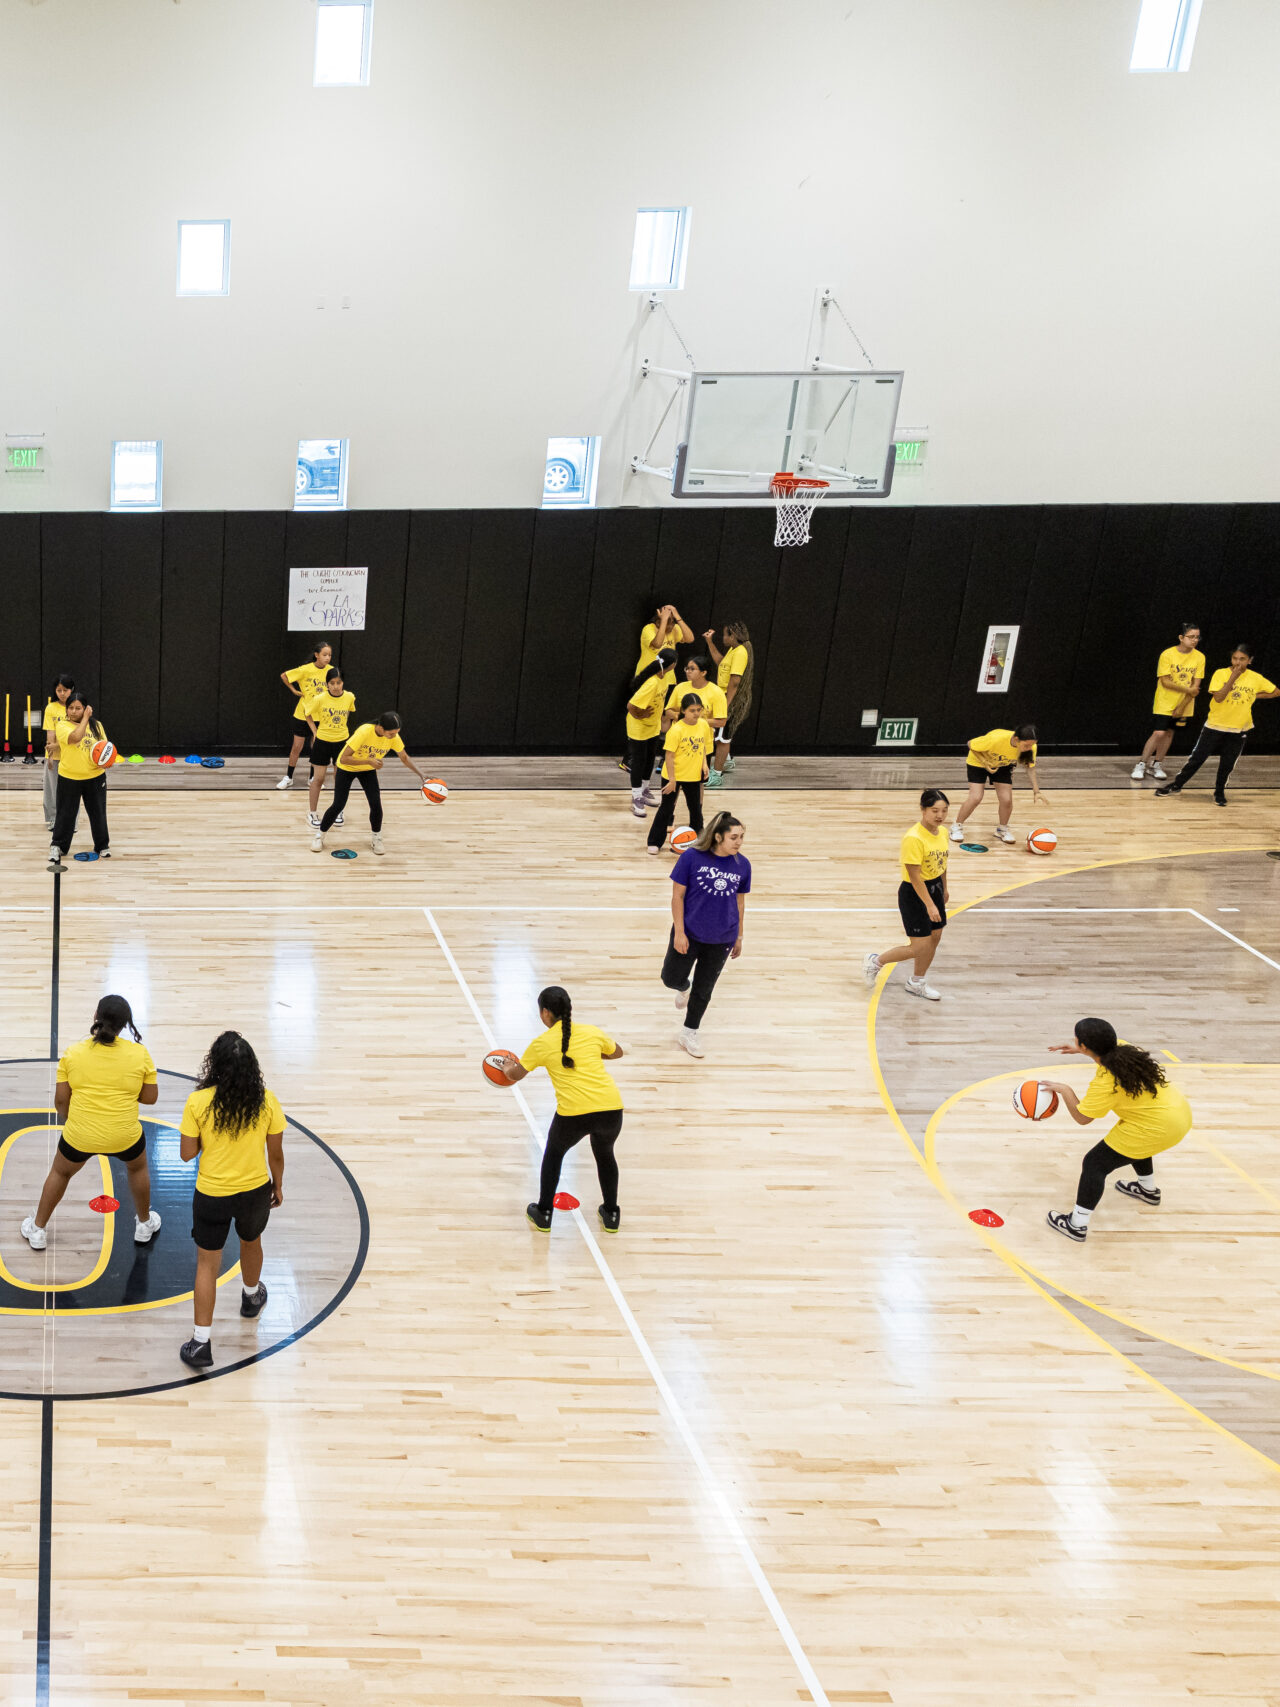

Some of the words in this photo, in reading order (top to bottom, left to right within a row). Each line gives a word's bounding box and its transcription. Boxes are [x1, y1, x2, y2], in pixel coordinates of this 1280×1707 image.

[14, 449, 38, 467] EXIT
[895, 443, 920, 460] EXIT
[333, 594, 349, 608] LA
[308, 600, 365, 628] SPARKS
[884, 722, 911, 739] EXIT
[705, 866, 742, 883] SPARKS
